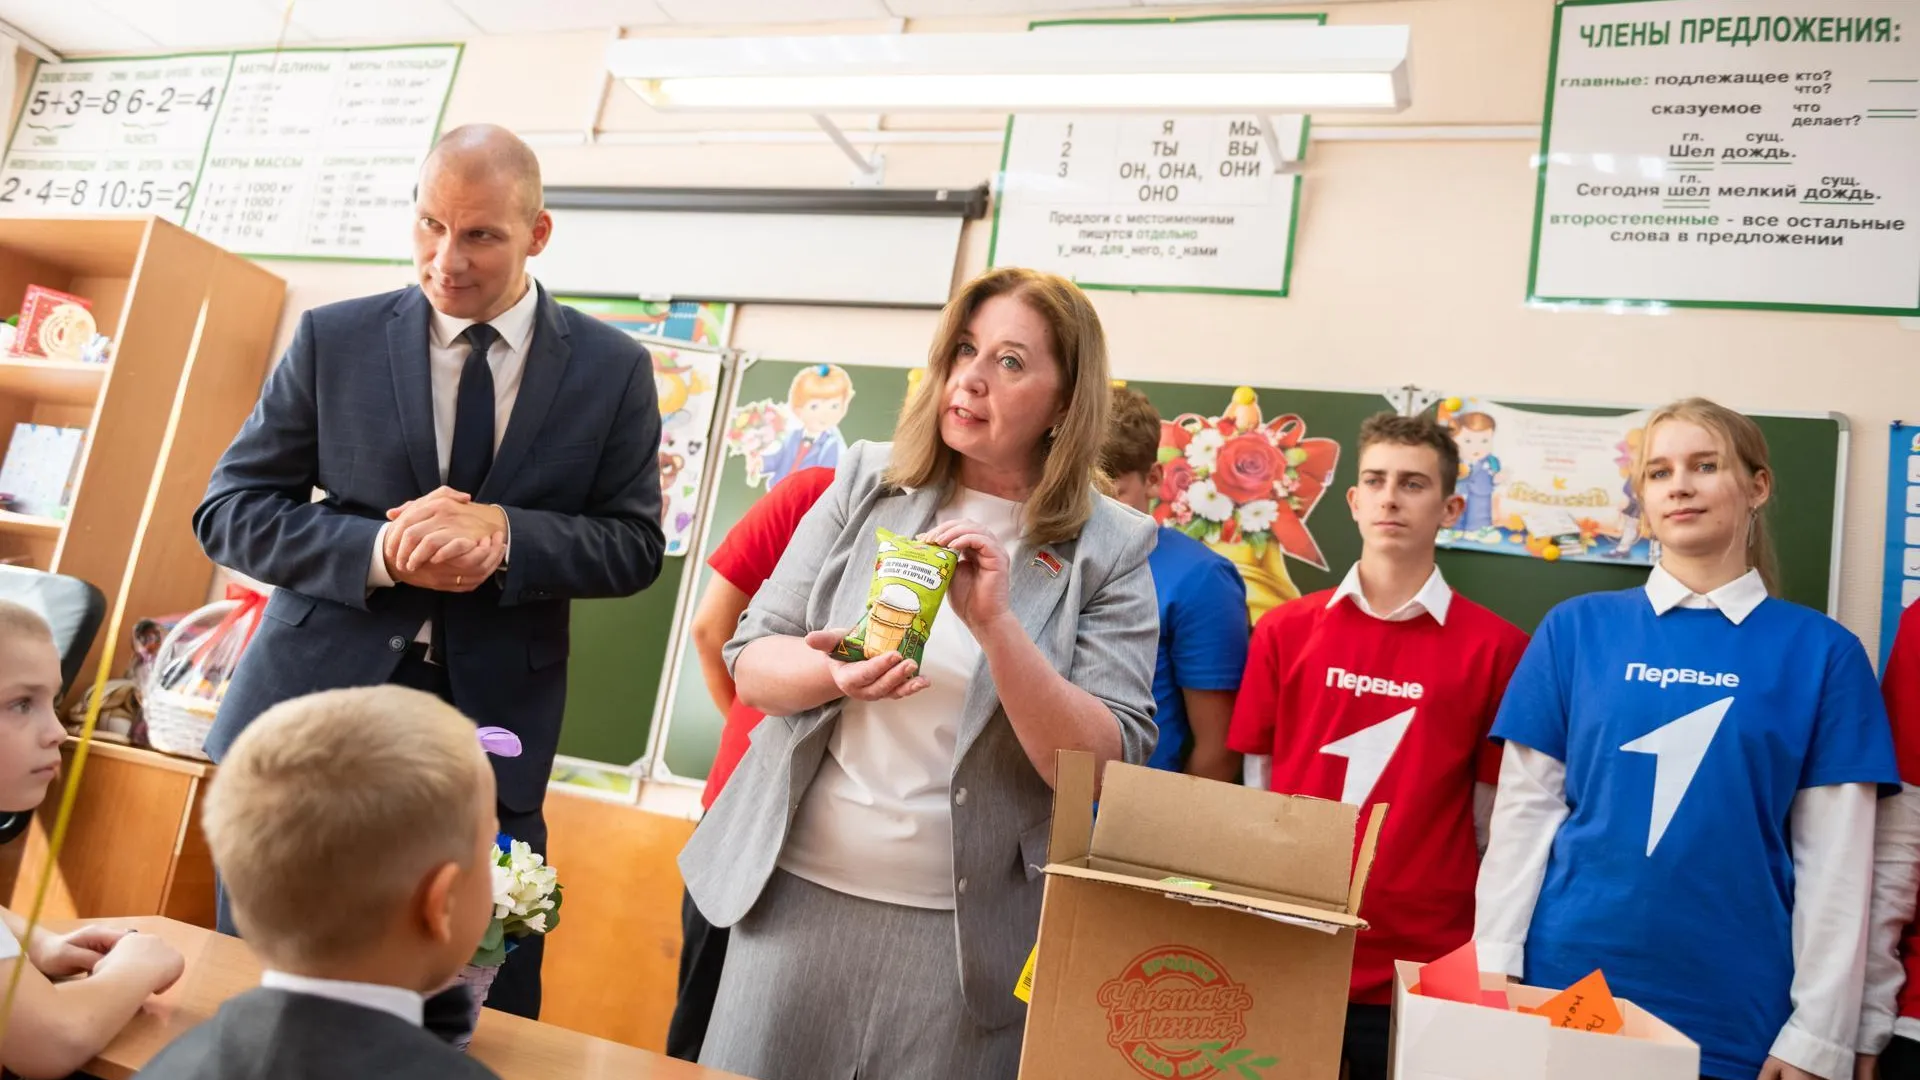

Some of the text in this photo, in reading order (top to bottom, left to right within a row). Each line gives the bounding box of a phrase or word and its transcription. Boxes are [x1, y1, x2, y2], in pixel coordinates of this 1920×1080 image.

[1580, 16, 1900, 47] ЧЛЕНЫ ПРЕДЛОЖЕНИЯ:
[1561, 70, 1832, 87] главные: подлежащее кто?
[1795, 83, 1831, 94] что?
[1652, 104, 1820, 117] сказуемое что
[1163, 120, 1174, 134] Я
[1792, 115, 1861, 127] делает?
[1068, 123, 1073, 137] 1
[1683, 133, 1783, 144] гл. сущ.
[1061, 141, 1071, 157] 2
[1153, 141, 1178, 156] ТЫ
[1229, 141, 1258, 156] ВЫ
[1670, 145, 1796, 159] Шел дождь.
[1058, 161, 1068, 178] 3
[1120, 162, 1202, 181] ОН, ОНА,
[1220, 161, 1260, 177] ОНИ
[1680, 175, 1860, 188] гл. сущ.
[1139, 185, 1178, 202] ОНО
[1577, 183, 1881, 201] Сегодня шел мелкий дождь.
[1050, 211, 1235, 225] Предлоги с местоимениями
[1550, 215, 1719, 227] второстепенные
[1743, 216, 1779, 226] все
[1787, 217, 1905, 230] остальные
[1079, 230, 1198, 241] пишутся отдельно
[1611, 232, 1843, 245] слова в предложении
[1324, 665, 1425, 700] Первые
[1623, 661, 1741, 689] Первые
[1099, 981, 1251, 1012] Чистая
[1109, 1012, 1244, 1044] Линия
